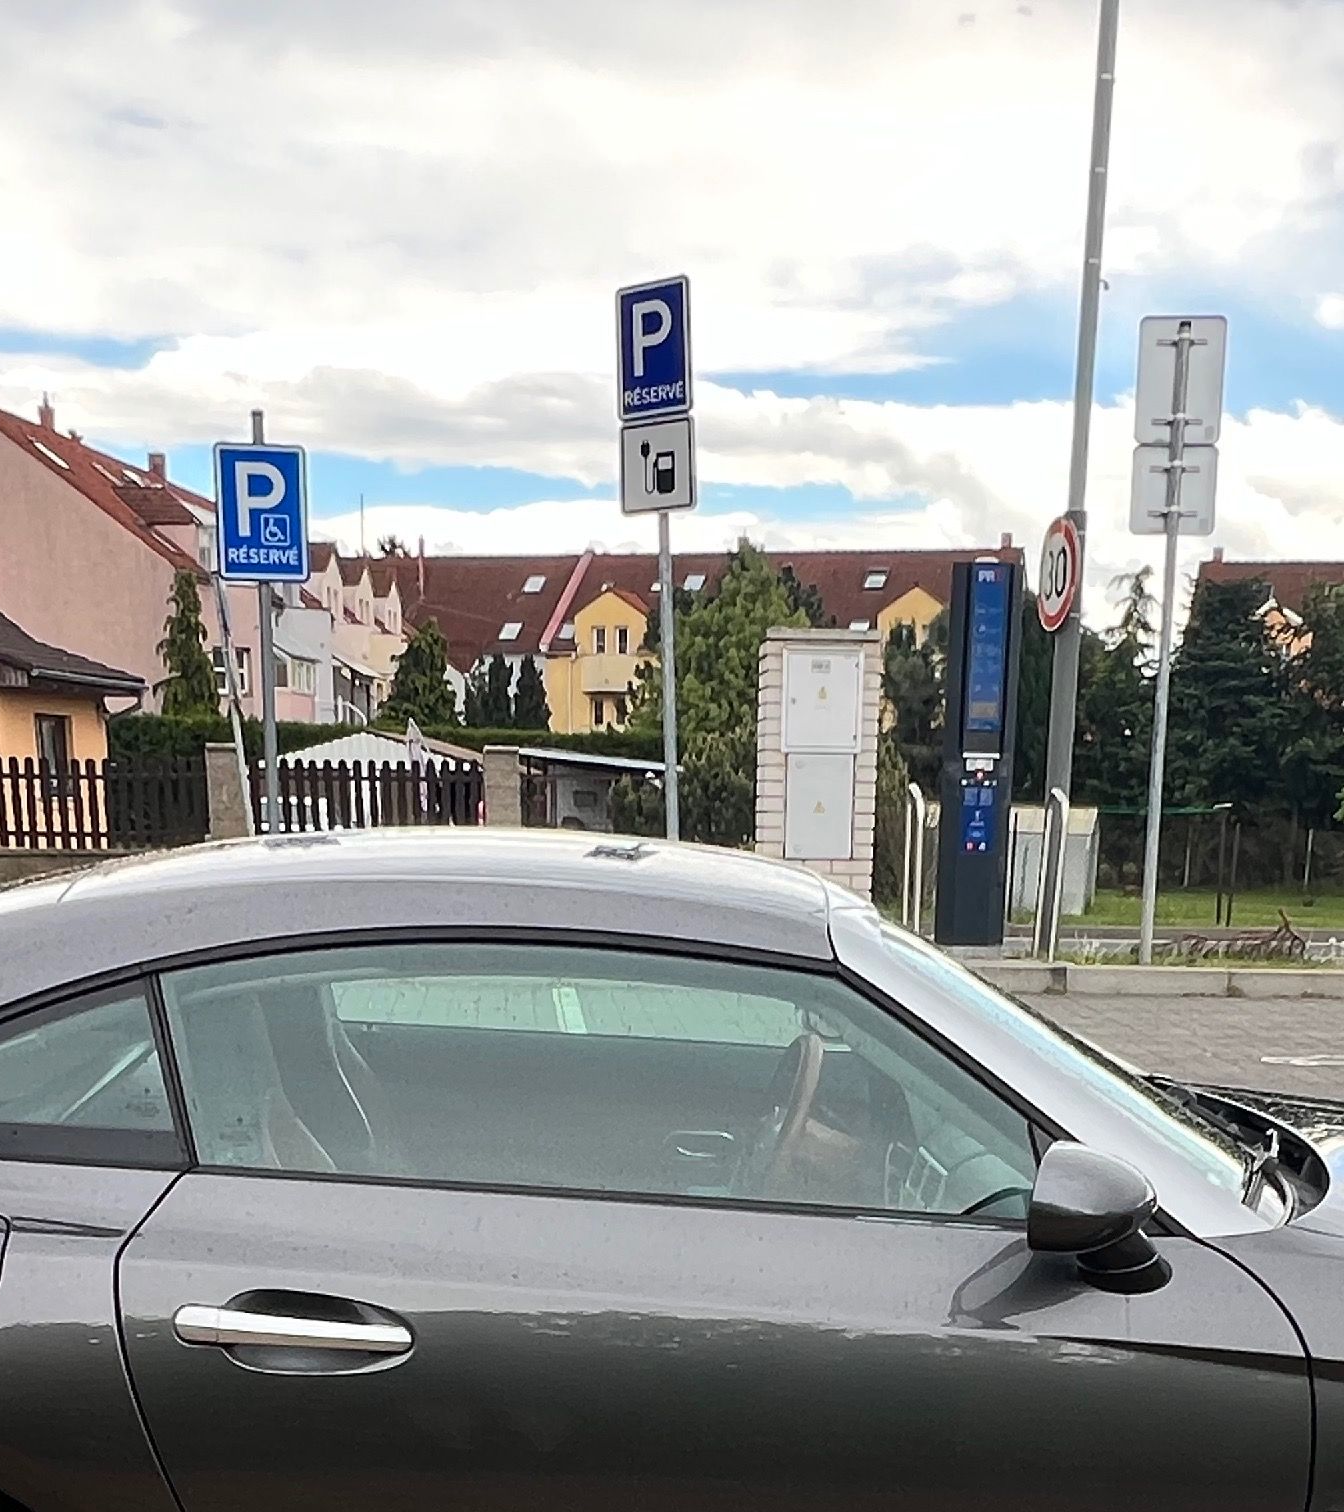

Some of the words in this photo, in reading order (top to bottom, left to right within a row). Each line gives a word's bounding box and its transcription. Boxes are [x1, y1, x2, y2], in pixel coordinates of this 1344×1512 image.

[633, 299, 672, 377] P
[624, 380, 684, 407] RÉSERVÉ
[235, 461, 286, 538] P
[227, 545, 299, 566] RÉSERVÉ
[1043, 546, 1067, 601] 30
